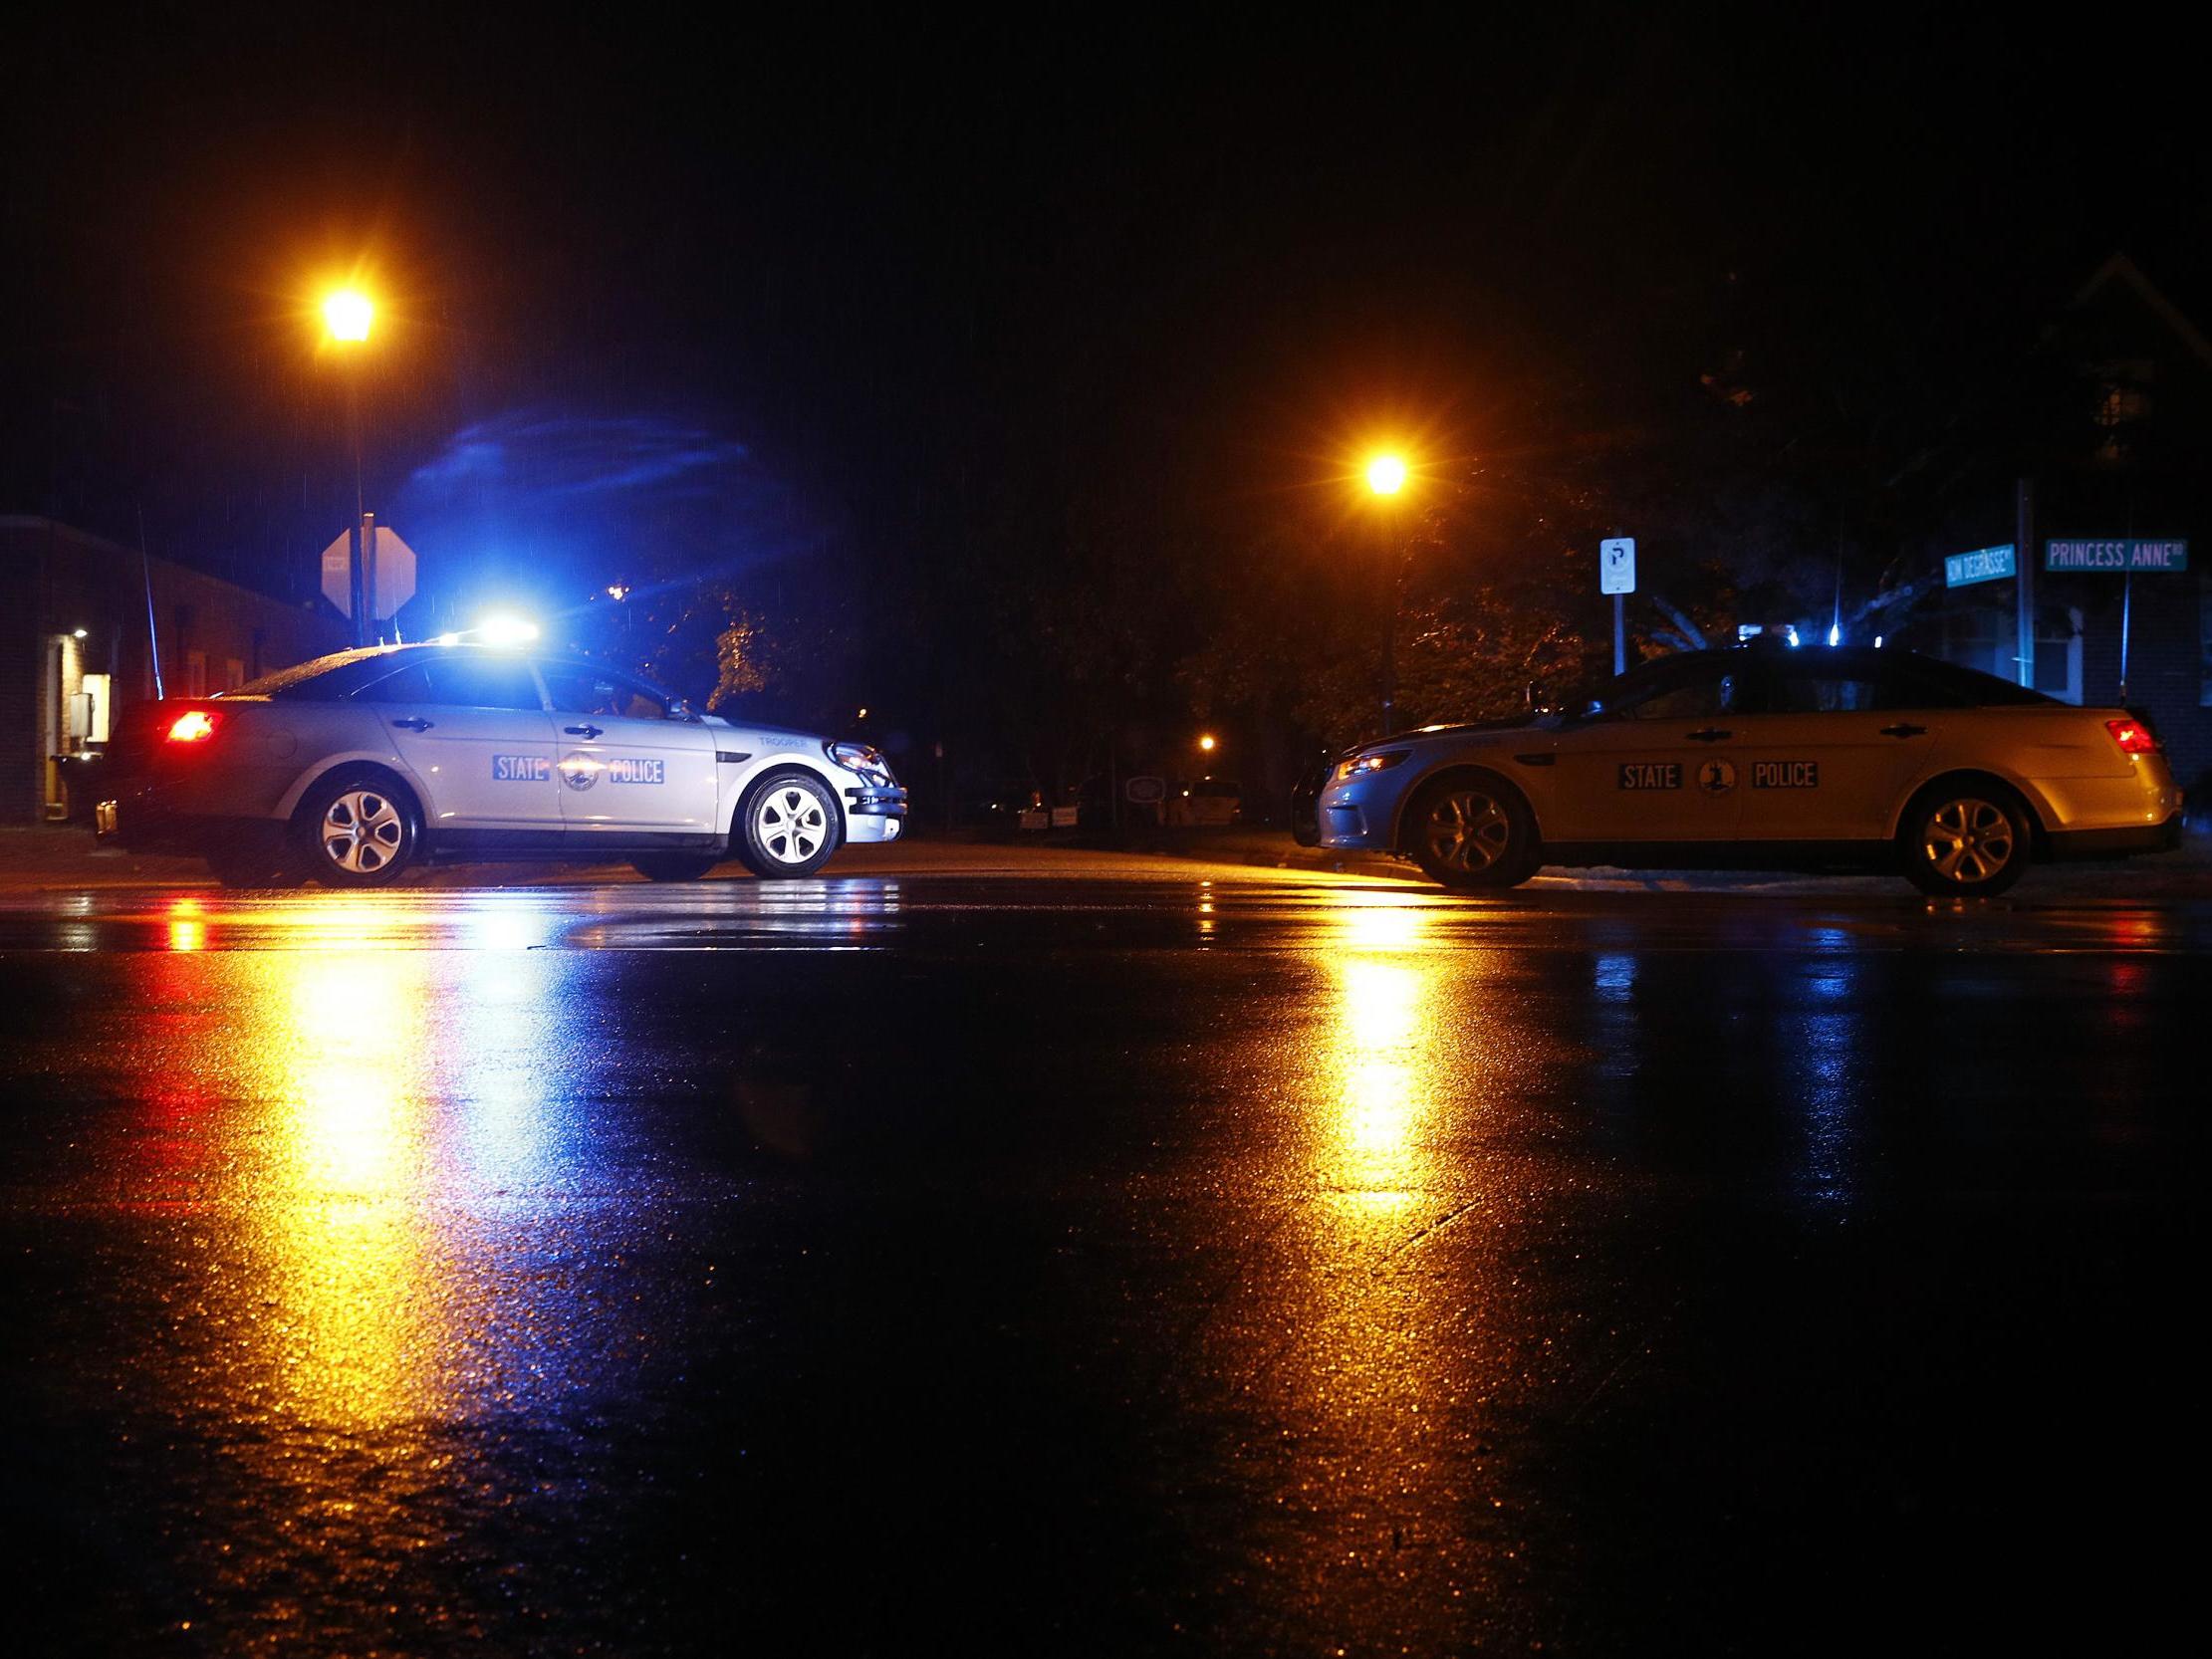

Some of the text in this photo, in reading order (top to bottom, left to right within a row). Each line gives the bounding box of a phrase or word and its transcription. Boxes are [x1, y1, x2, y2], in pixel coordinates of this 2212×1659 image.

[2050, 543, 2124, 567] PRINCESS
[2131, 543, 2171, 567] ANNE
[498, 756, 662, 783] STATE POLICE
[1624, 763, 1815, 788] STATE POLICE
